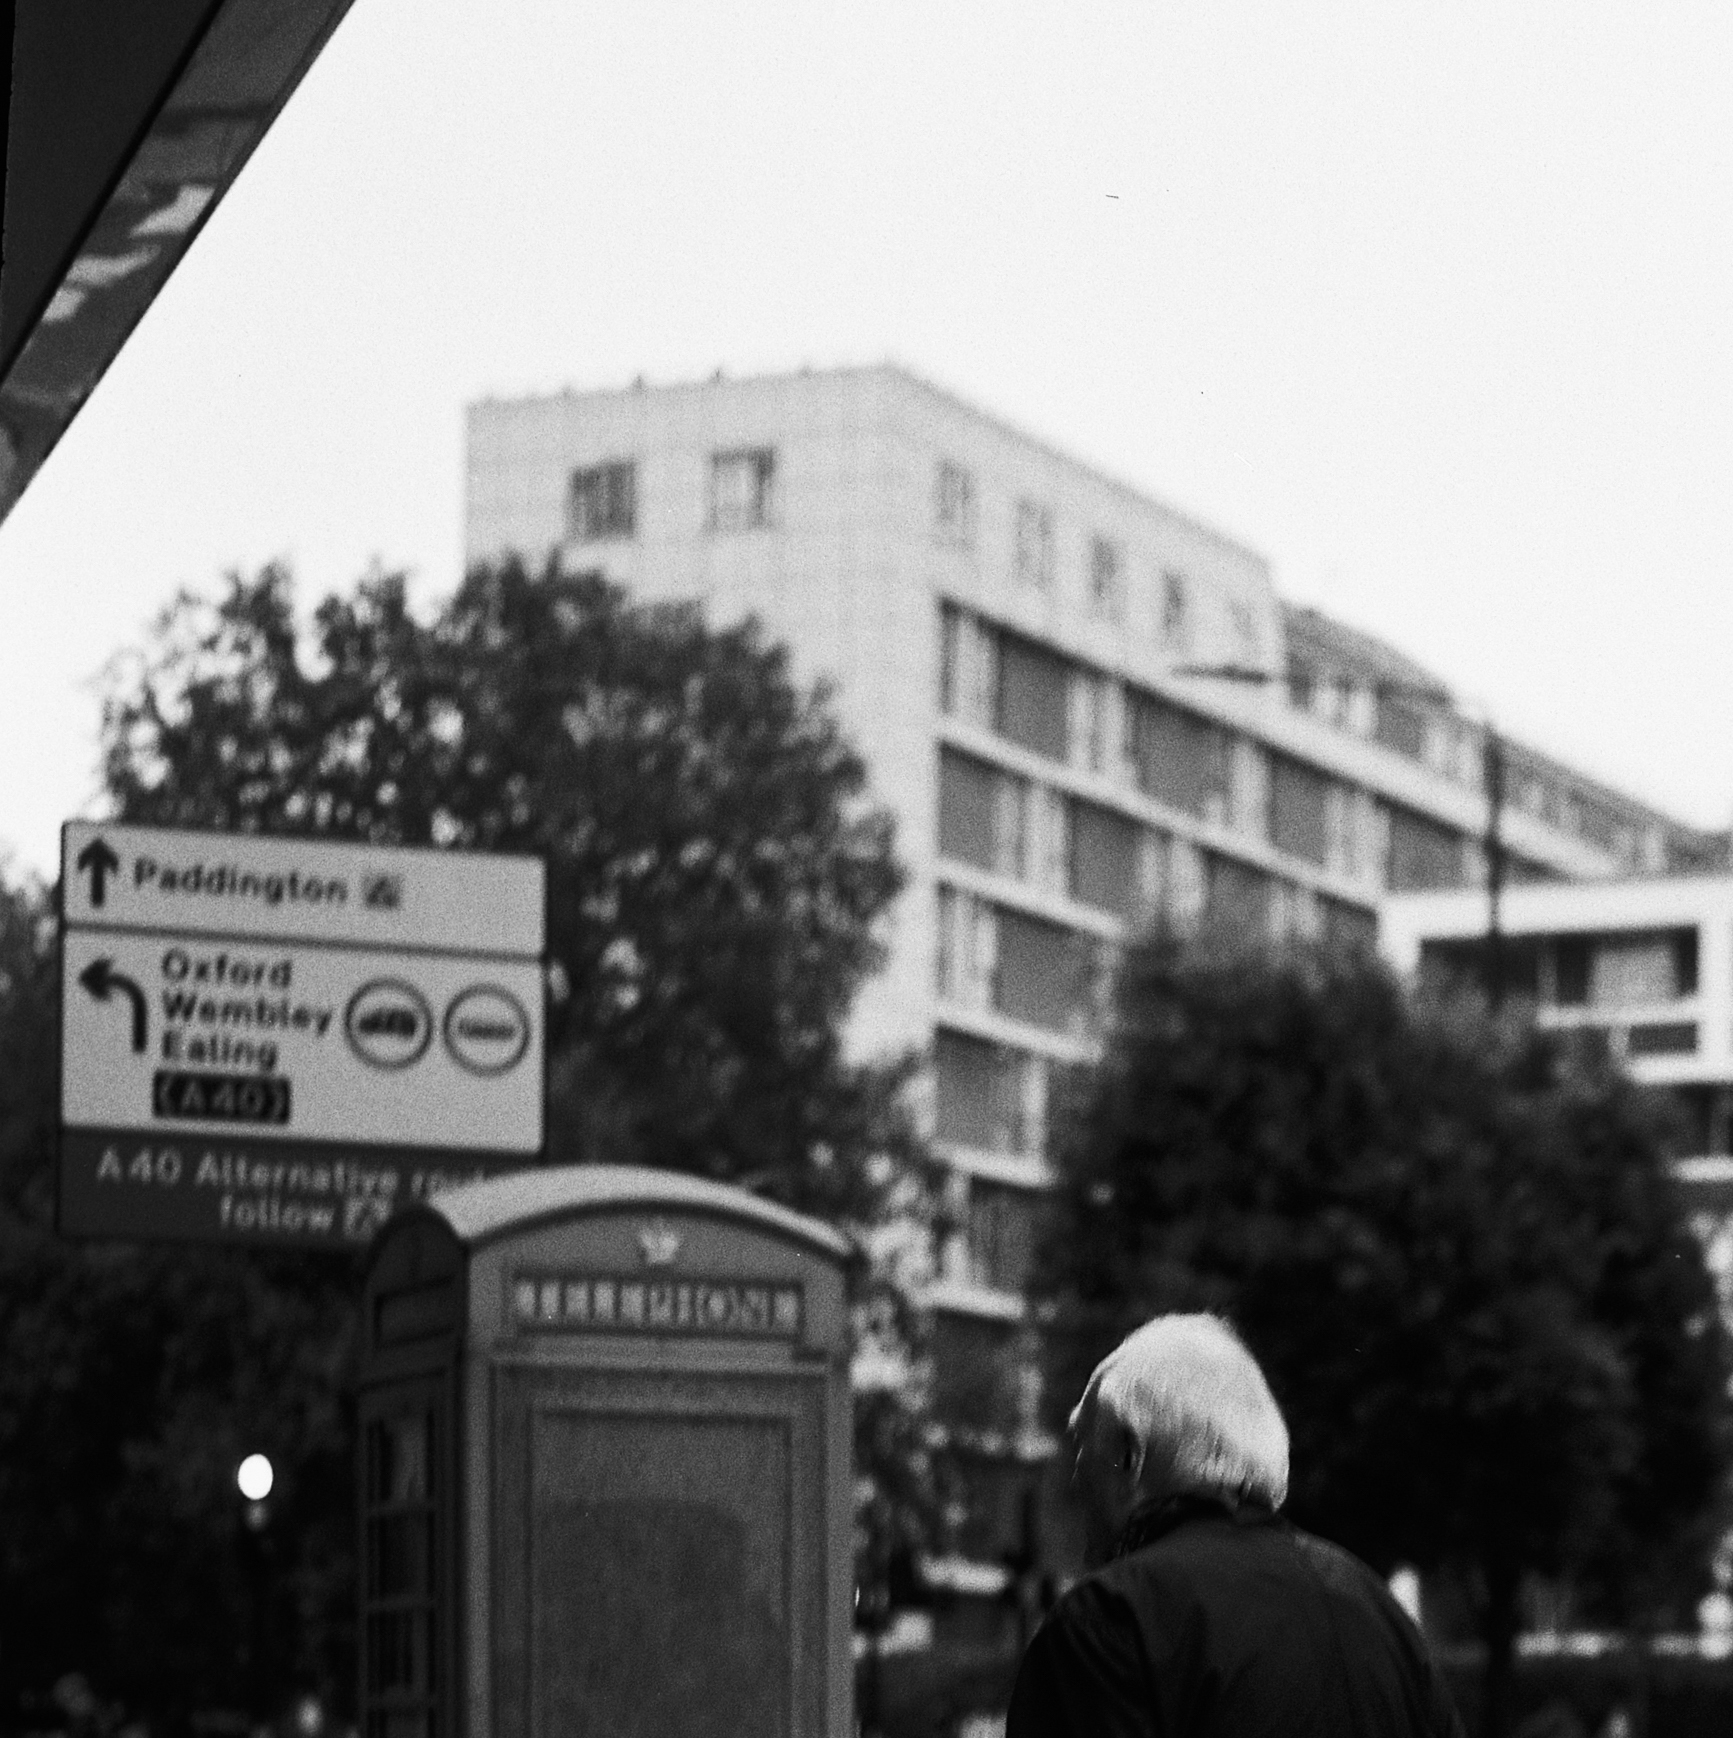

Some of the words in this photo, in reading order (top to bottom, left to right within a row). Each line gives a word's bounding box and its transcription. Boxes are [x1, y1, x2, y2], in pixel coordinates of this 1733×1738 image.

[134, 857, 348, 905] Paddington
[161, 948, 292, 988] Oxford
[161, 992, 333, 1036] Wembley
[161, 1032, 278, 1073] Ealing
[197, 1151, 398, 1197] Alternative
[220, 1195, 334, 1233] follow
